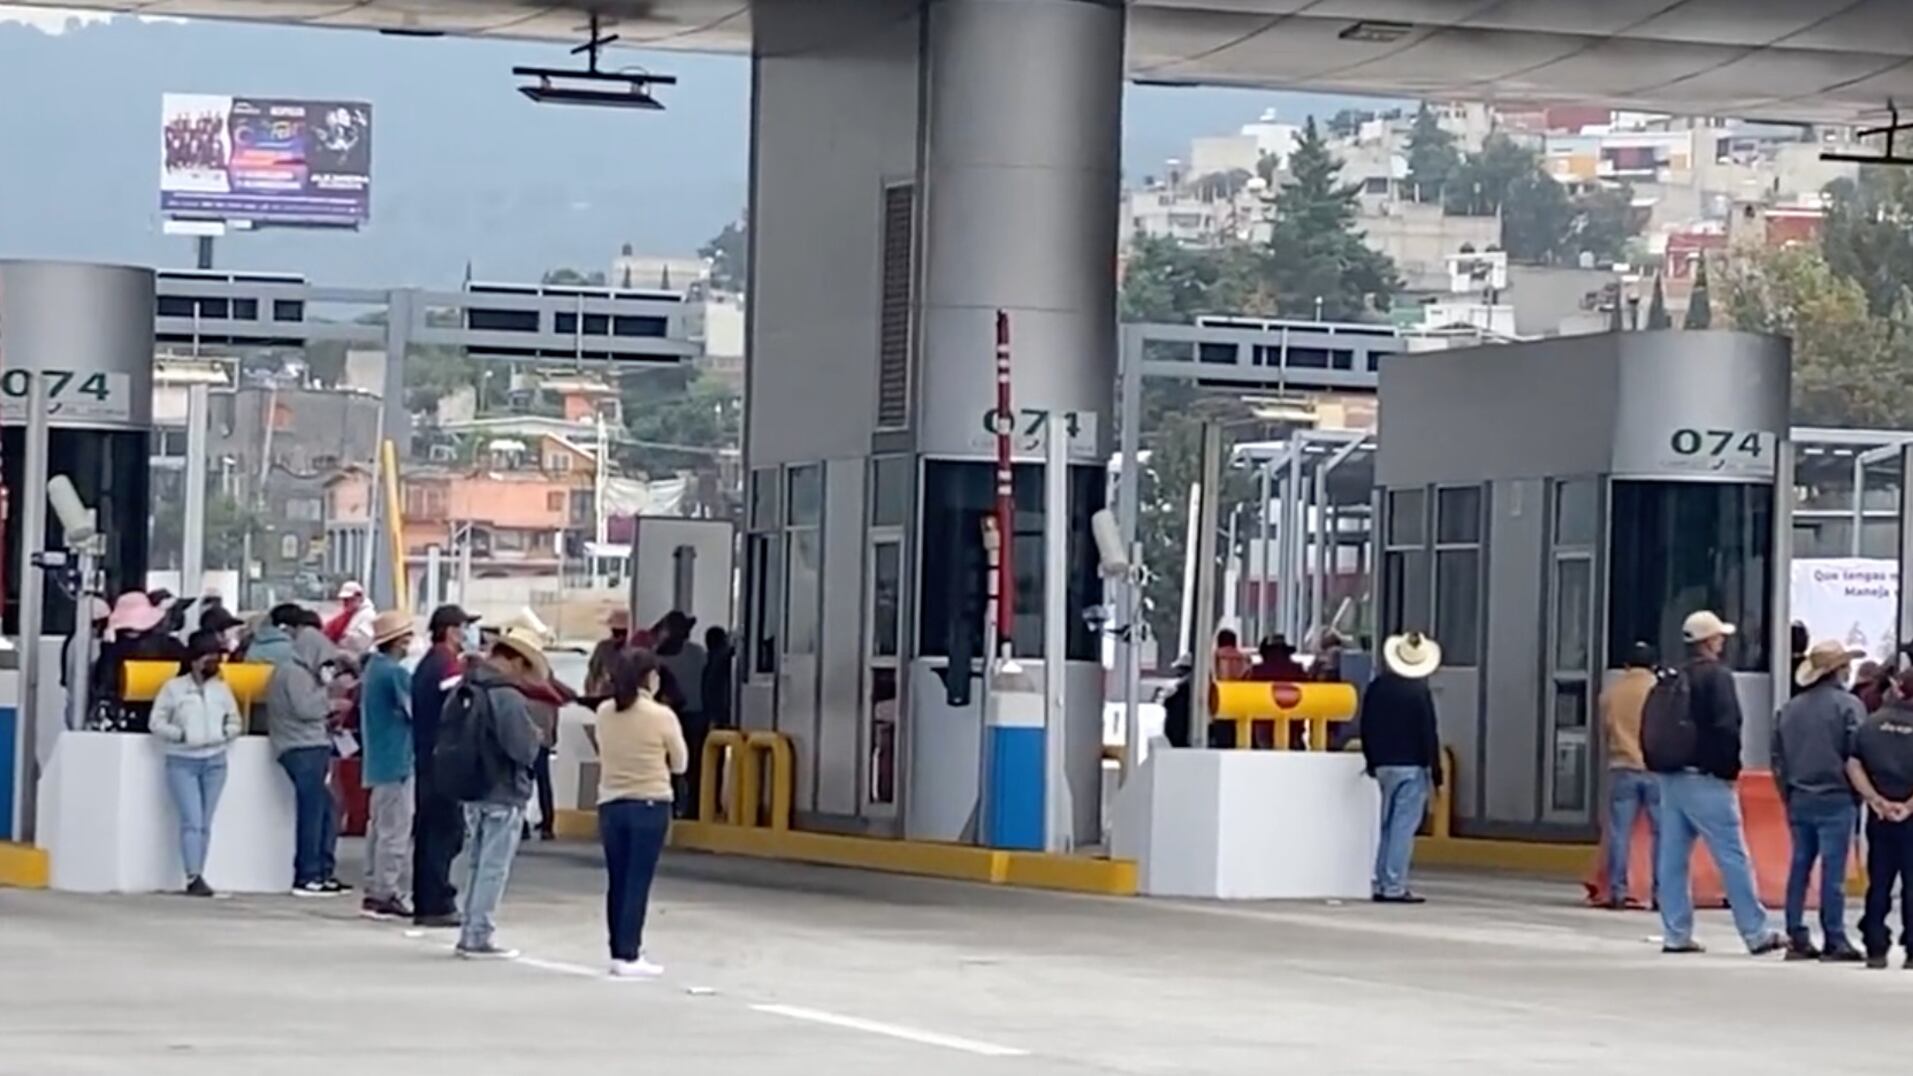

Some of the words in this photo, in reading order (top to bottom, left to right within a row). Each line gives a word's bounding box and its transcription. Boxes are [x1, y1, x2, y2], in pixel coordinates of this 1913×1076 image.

[2, 369, 110, 401] 074
[1671, 428, 1762, 457] 074
[1814, 569, 1838, 581] Que
[1843, 570, 1886, 582] tengas
[1845, 586, 1889, 598] Maneja
